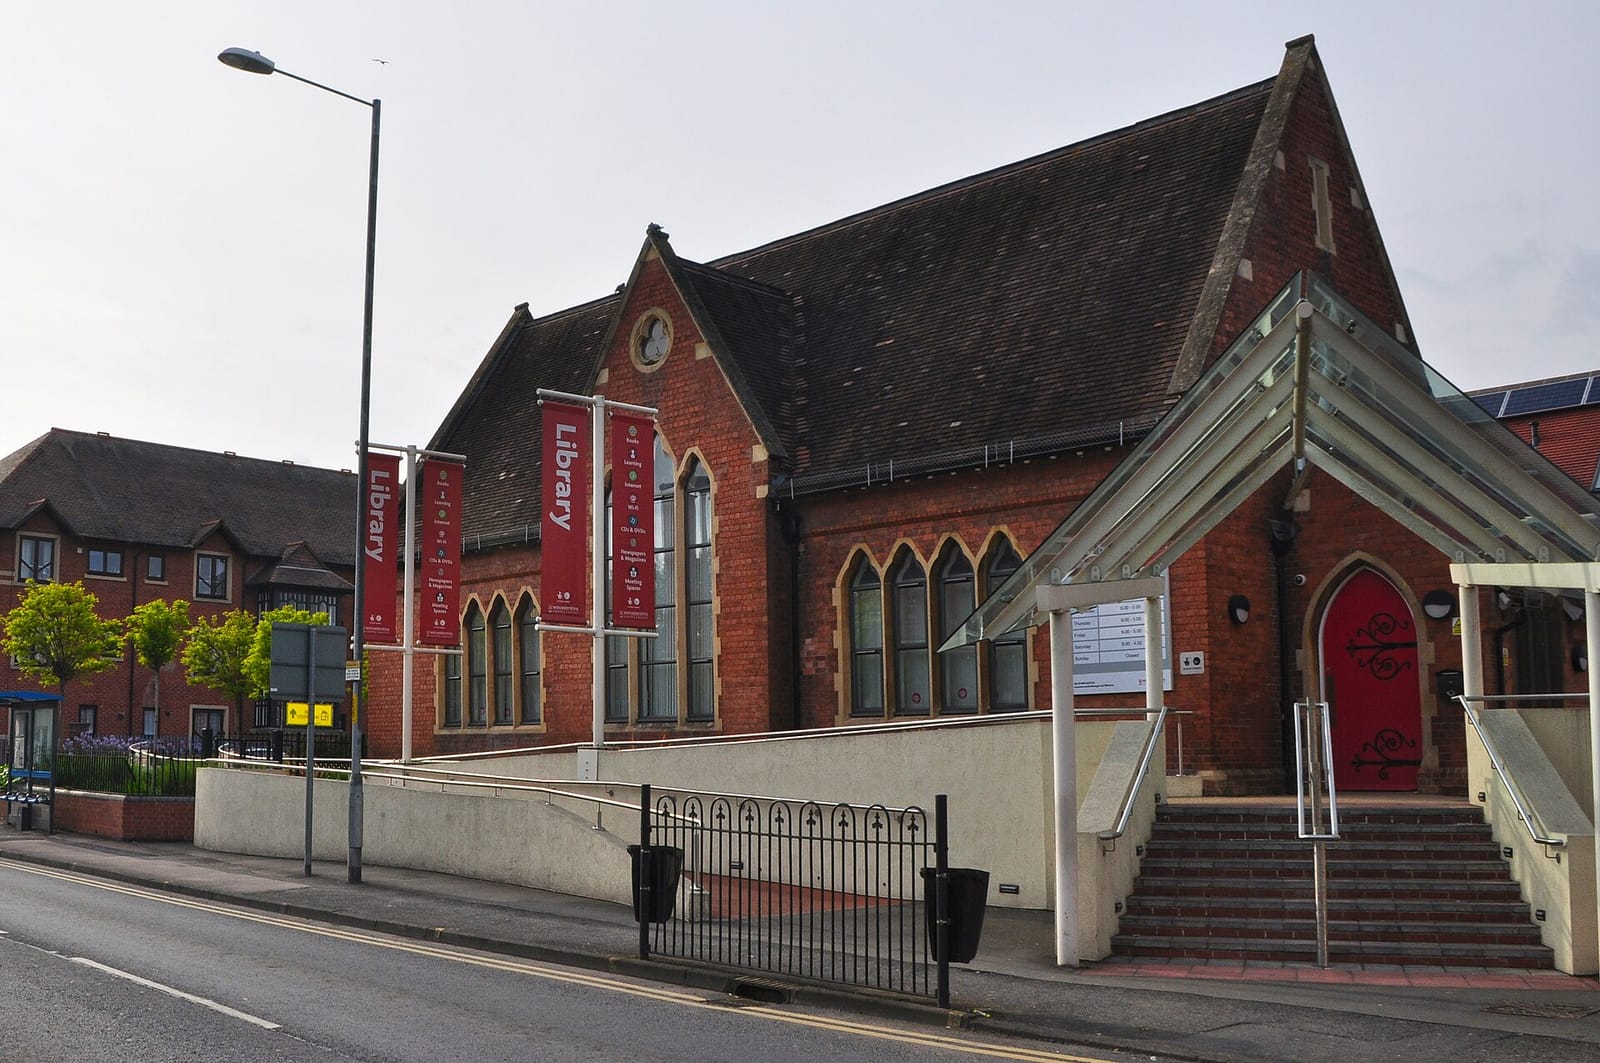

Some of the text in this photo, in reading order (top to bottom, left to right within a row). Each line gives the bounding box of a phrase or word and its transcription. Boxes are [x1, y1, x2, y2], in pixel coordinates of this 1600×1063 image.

[626, 437, 640, 445] Books
[624, 459, 642, 468] Learning
[549, 423, 578, 531] Library
[365, 470, 391, 562] Library
[620, 549, 646, 557] Newspapers
[625, 555, 646, 563] Magazines
[428, 577, 453, 585] Newspapers
